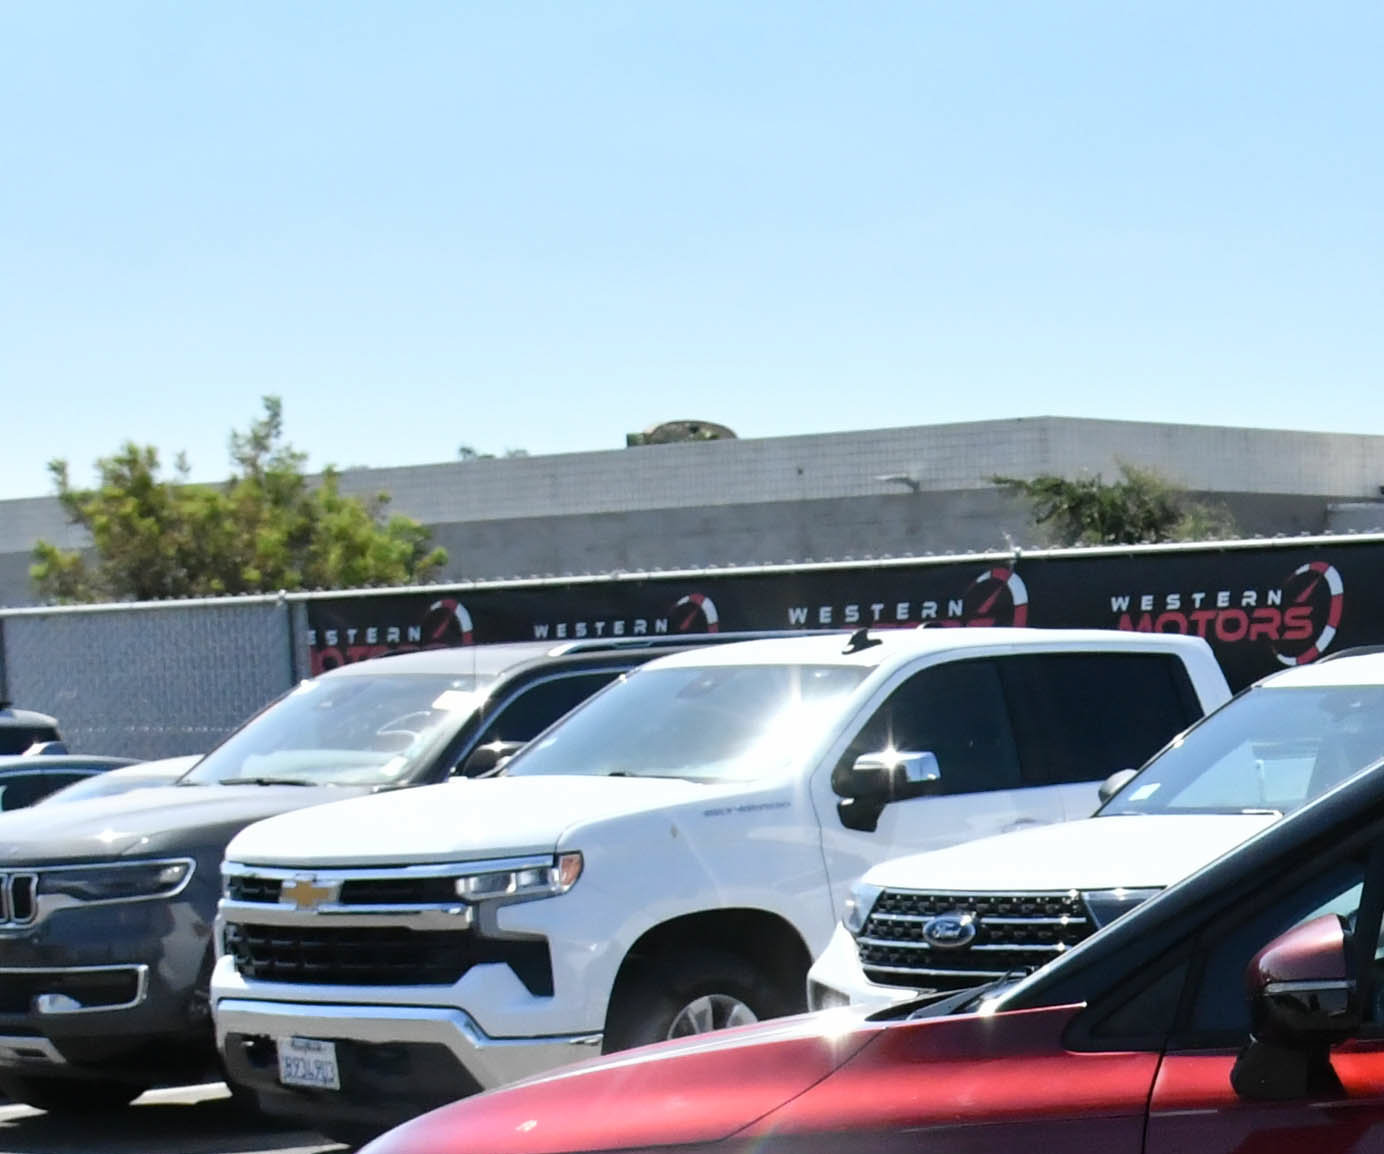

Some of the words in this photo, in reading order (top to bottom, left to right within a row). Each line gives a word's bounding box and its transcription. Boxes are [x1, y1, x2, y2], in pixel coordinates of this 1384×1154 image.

[788, 599, 963, 624] WESTERN
[1111, 589, 1282, 612] WESTERN
[309, 625, 421, 645] ESTERN
[534, 618, 668, 639] WESTERN
